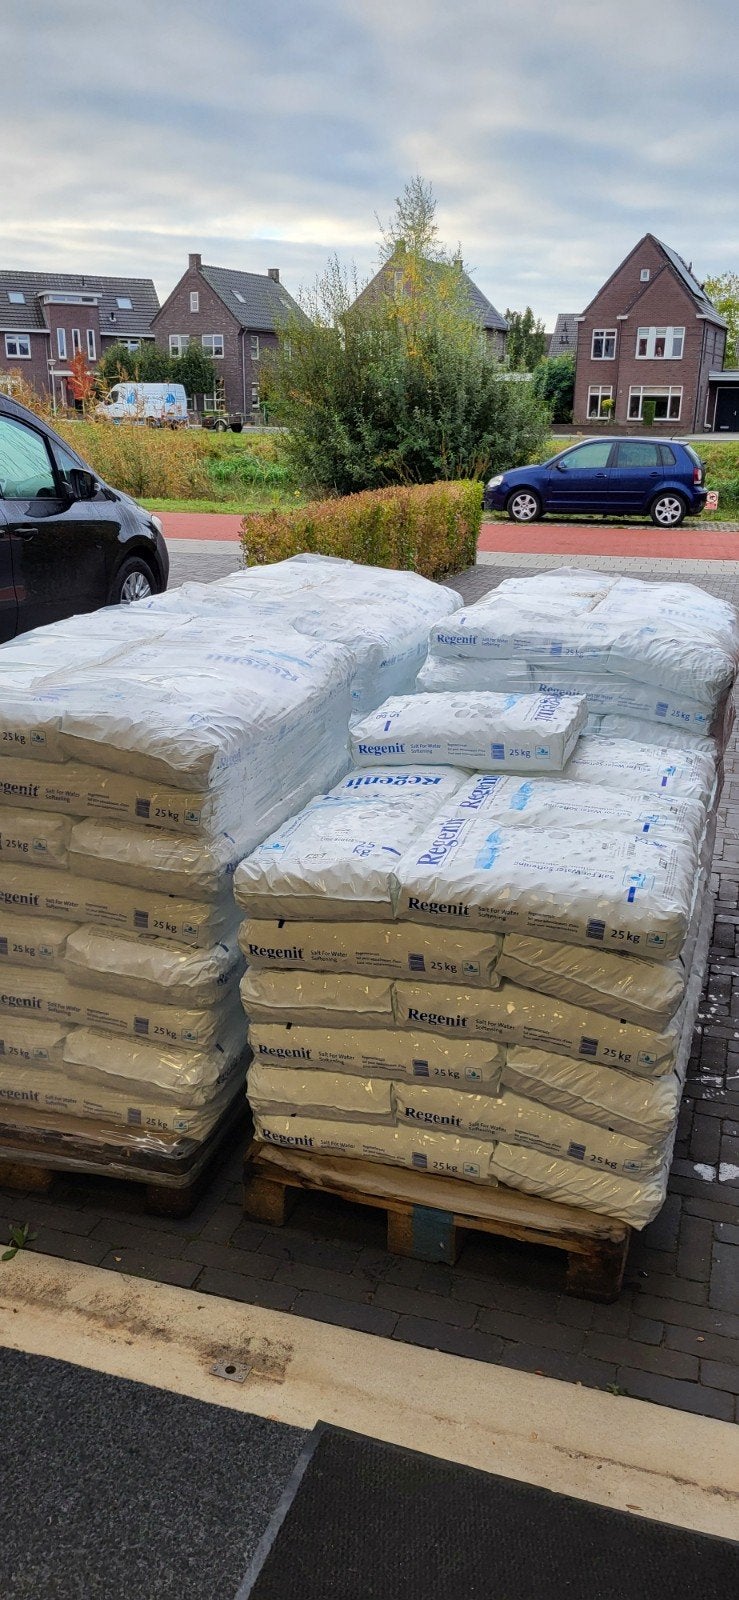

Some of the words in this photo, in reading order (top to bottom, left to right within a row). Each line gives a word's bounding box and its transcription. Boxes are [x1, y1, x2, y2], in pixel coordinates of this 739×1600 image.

[437, 634, 476, 645] Regenit
[680, 710, 690, 721] kg
[2, 732, 14, 741] 25
[14, 732, 26, 744] kg
[358, 743, 405, 756] Regenit
[510, 748, 519, 756] 25
[521, 748, 531, 758] kg
[0, 781, 39, 796] genit
[345, 775, 442, 789] Regenit
[155, 808, 166, 817] 25
[168, 810, 178, 821] kg
[6, 839, 16, 848] 25
[16, 840, 29, 852] kg
[416, 819, 466, 865] Regenit
[0, 890, 39, 906] egenit
[408, 897, 470, 915] Regenit
[153, 920, 164, 929] 25
[166, 922, 177, 933] kg
[611, 929, 624, 940] 25
[626, 930, 640, 944] kg
[12, 944, 23, 953] 25
[24, 945, 35, 956] kg
[248, 944, 304, 959] Regenit
[430, 961, 442, 970] 25
[444, 962, 457, 973] kg
[1, 994, 41, 1008] egenit
[408, 1008, 467, 1026] Regenit
[154, 1026, 164, 1034] 25
[166, 1029, 176, 1039] kg
[498, 1022, 515, 1030] Water
[9, 1047, 19, 1056] 25
[19, 1048, 30, 1059] kg
[259, 1044, 311, 1059] Regenit
[603, 1047, 616, 1057] 25
[618, 1050, 631, 1062] kg
[434, 1068, 445, 1077] 25
[448, 1069, 460, 1079] kg
[0, 1089, 39, 1101] egenit
[146, 1117, 156, 1125] 25
[157, 1120, 168, 1130] kg
[404, 1107, 462, 1127] Regenit
[263, 1129, 314, 1146] Regenit
[433, 1161, 444, 1170] 25
[446, 1163, 458, 1172] kg
[590, 1155, 603, 1164] 25
[605, 1158, 618, 1170] kg
